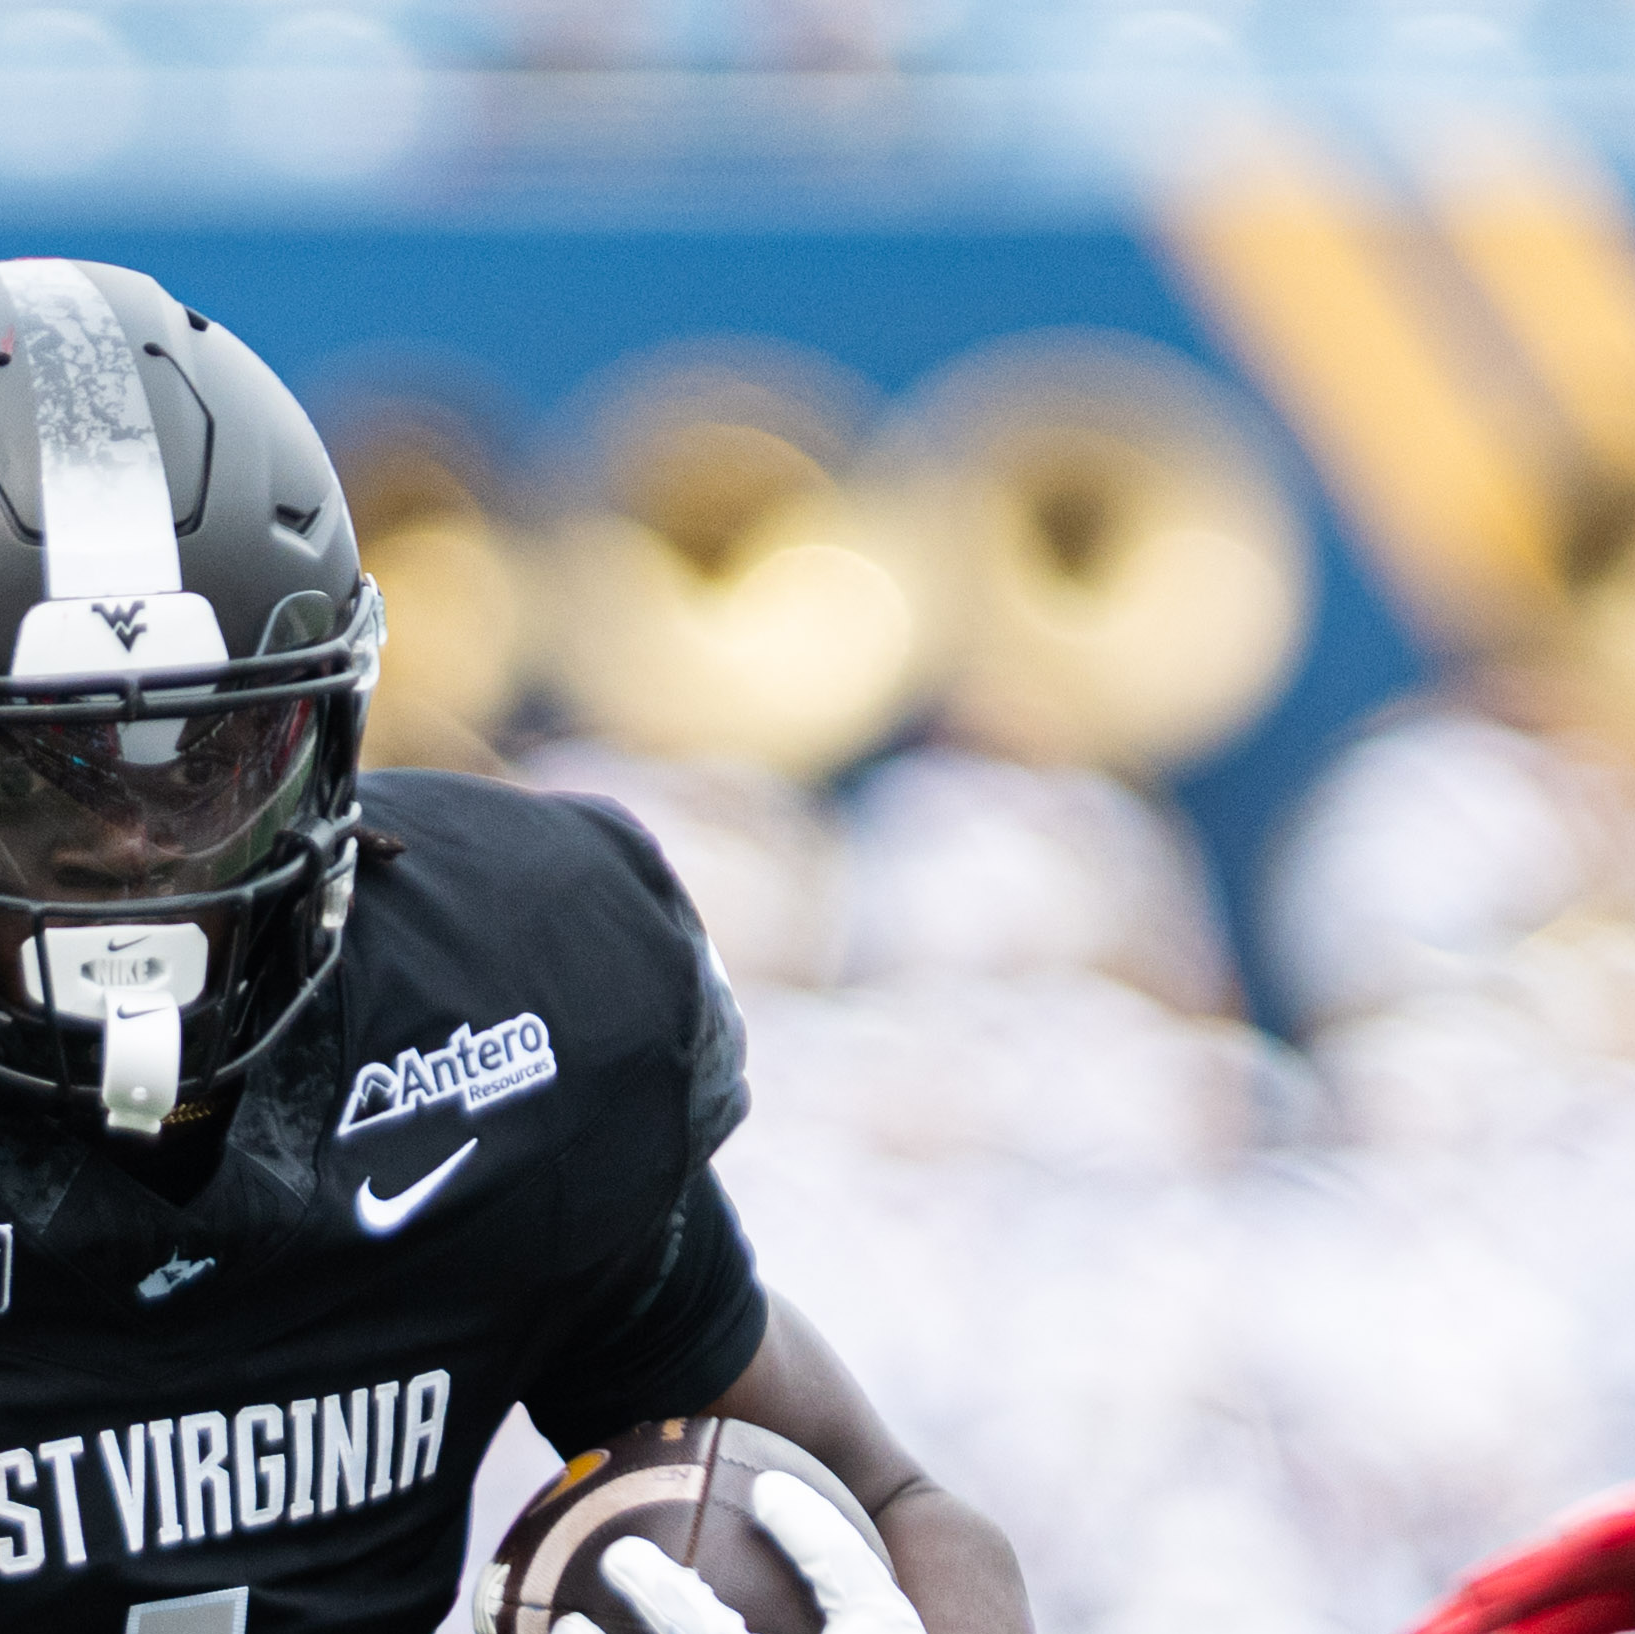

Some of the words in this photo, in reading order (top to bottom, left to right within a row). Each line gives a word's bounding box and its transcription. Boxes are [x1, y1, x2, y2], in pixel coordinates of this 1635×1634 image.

[401, 1020, 543, 1105] Antero
[468, 1059, 550, 1102] Resources
[99, 1369, 450, 1555] VIRGINIA
